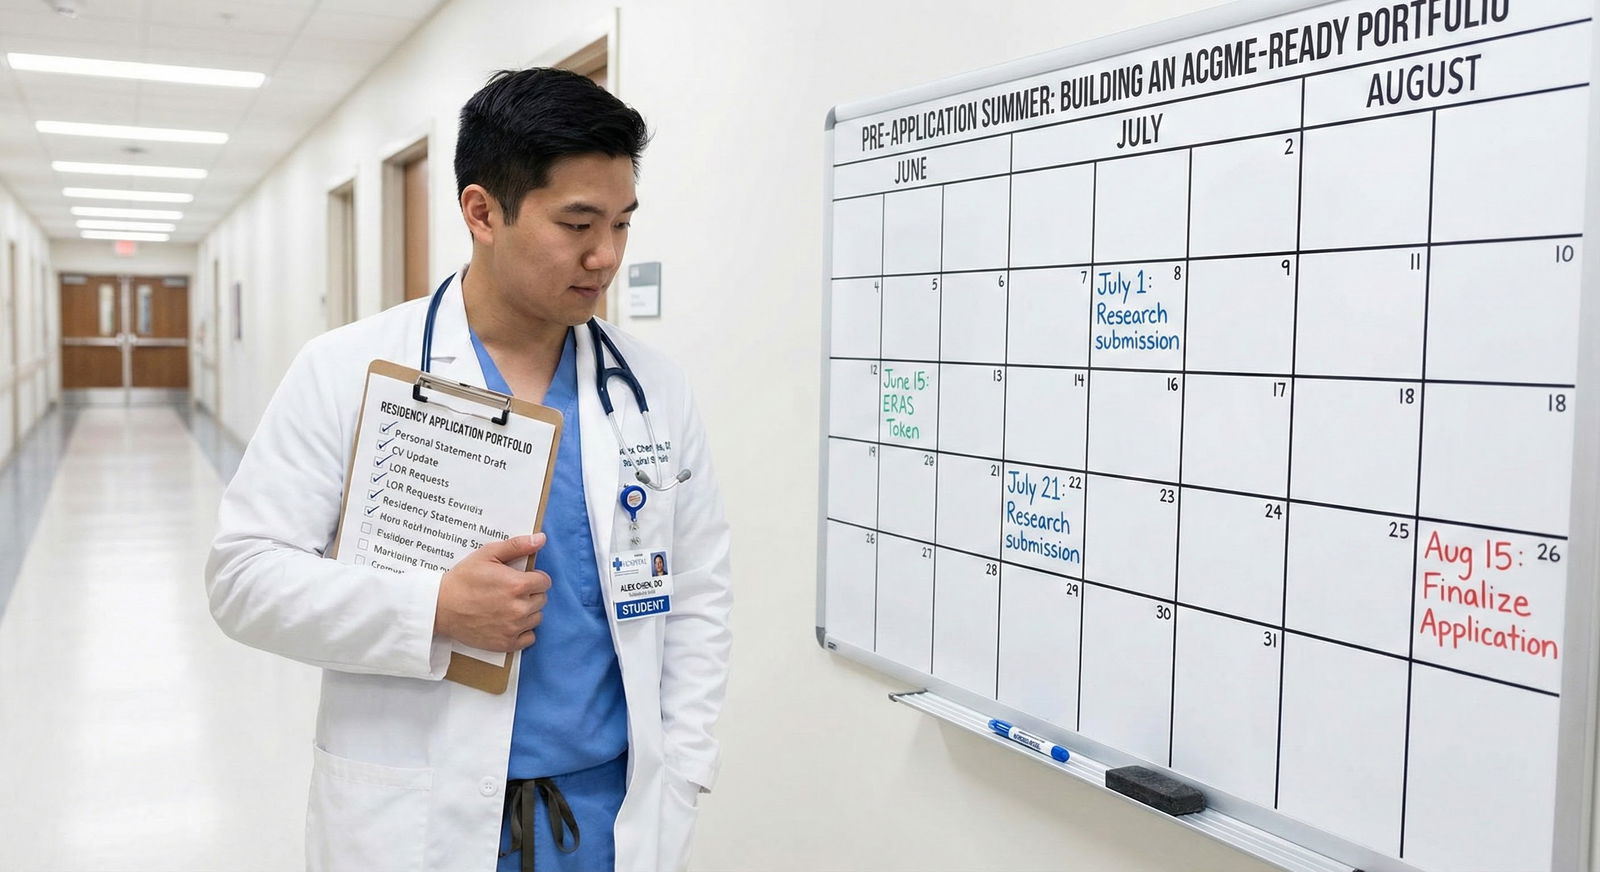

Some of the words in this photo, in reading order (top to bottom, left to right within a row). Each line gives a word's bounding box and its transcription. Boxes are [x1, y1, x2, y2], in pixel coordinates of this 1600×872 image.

[862, 101, 977, 152] PRE-APPLICATION
[981, 84, 1056, 129] SUMMER:
[1060, 63, 1143, 112] BUILDING
[1148, 56, 1177, 94] AN
[1182, 16, 1350, 87] ACGME-READY
[1357, 0, 1510, 51] PORTFOLIO
[1366, 53, 1483, 108] AUGUST
[1116, 113, 1164, 150] JULY
[1283, 138, 1294, 155] 2
[894, 156, 928, 185] JUNE
[1411, 252, 1420, 270] 11
[1556, 245, 1575, 263] 10
[1174, 265, 1182, 280] 8
[1281, 259, 1291, 276] 9
[931, 278, 938, 291] 5
[998, 275, 1005, 288] 6
[1081, 271, 1088, 284] 7
[1097, 271, 1131, 304] July
[1136, 269, 1153, 294] 1:
[874, 281, 880, 293] 4
[1097, 302, 1168, 325] Research
[1095, 329, 1180, 350] submission
[870, 365, 878, 375] 12
[993, 369, 1003, 382] 13
[883, 368, 910, 391] June
[913, 371, 930, 391] 15:
[1074, 373, 1085, 387] 14
[1167, 377, 1179, 391] 16
[1273, 382, 1287, 397] 17
[1400, 388, 1415, 404] 18
[883, 394, 915, 415] ERAS
[1549, 394, 1567, 412] 18
[380, 401, 428, 424] RESIDENCY
[429, 415, 484, 440] APPLICATION
[485, 431, 533, 455] PORTFOLIO
[886, 418, 920, 439] Token
[391, 446, 405, 457] CV
[406, 450, 439, 467] Update
[395, 429, 434, 448] Personal
[435, 441, 482, 461] Statement
[483, 455, 508, 470] Draft
[389, 463, 407, 475] LOR
[409, 468, 450, 488] Requests
[990, 464, 1000, 477] 21
[1007, 470, 1037, 505] July
[1041, 476, 1066, 501] 21:
[1068, 476, 1082, 490] 22
[386, 480, 404, 492] LOR
[406, 485, 446, 505] Requests
[1159, 488, 1175, 504] 23
[383, 496, 429, 517] Residency
[430, 510, 477, 531] Statement
[1007, 501, 1071, 535] Research
[1265, 503, 1282, 520] 24
[866, 533, 875, 544] 26
[1389, 521, 1409, 539] 25
[922, 547, 932, 559] 27
[1005, 530, 1080, 564] submission
[1424, 530, 1473, 581] Aug
[1486, 539, 1523, 571] 15:
[1537, 543, 1561, 563] 26
[985, 563, 998, 576] 28
[621, 583, 636, 592] ALEX
[1066, 583, 1079, 597] 29
[1424, 571, 1532, 617] Finalize
[622, 599, 665, 616] STUDENT
[1156, 605, 1171, 620] 30
[1263, 631, 1277, 648] 31
[1419, 607, 1558, 660] Application
